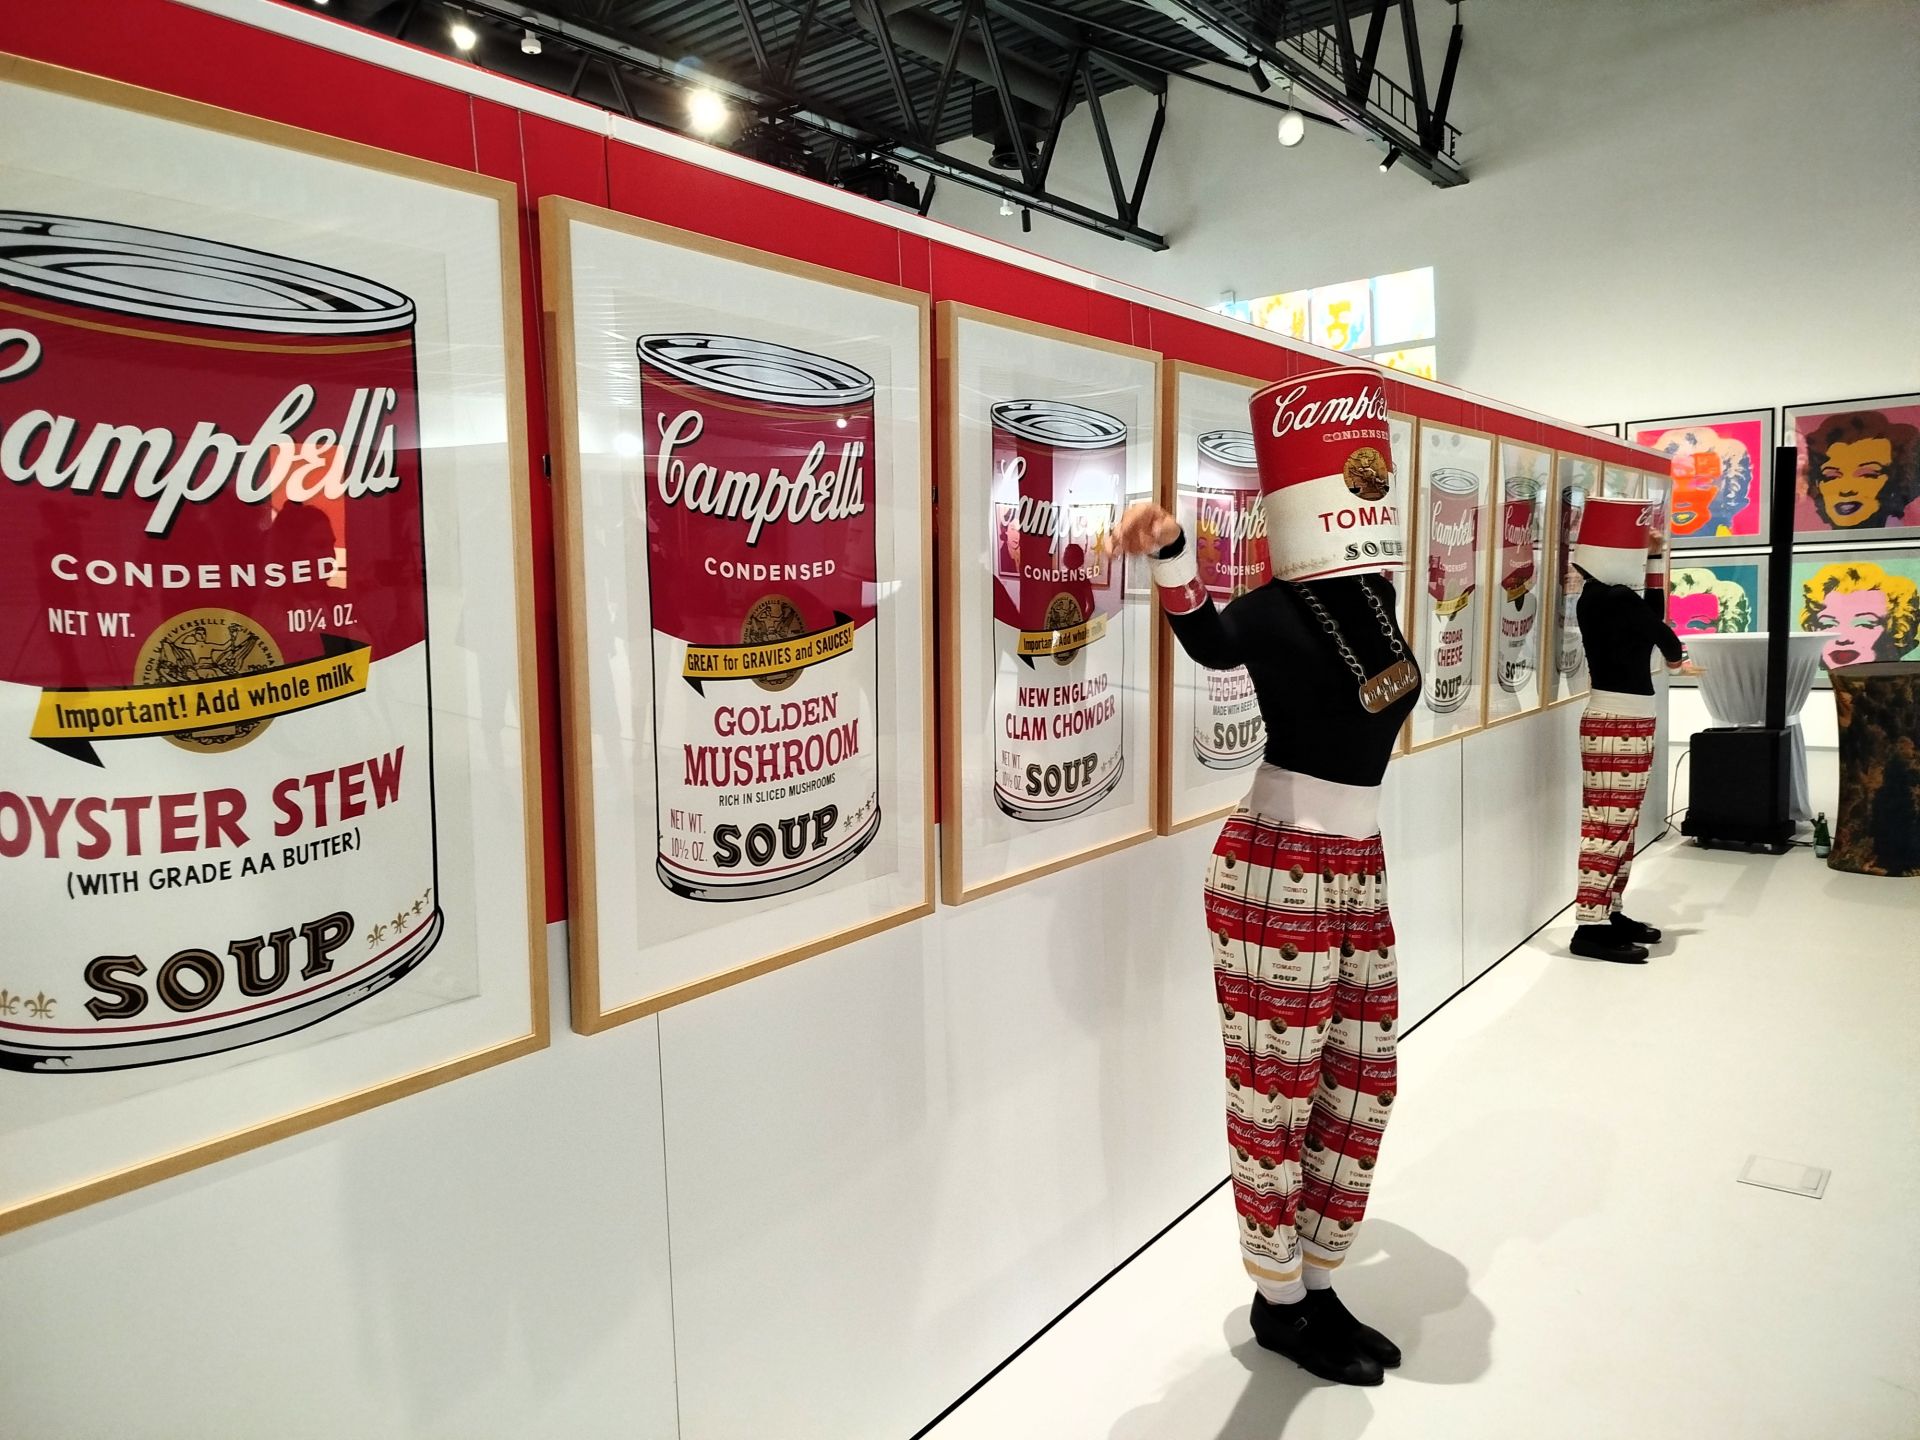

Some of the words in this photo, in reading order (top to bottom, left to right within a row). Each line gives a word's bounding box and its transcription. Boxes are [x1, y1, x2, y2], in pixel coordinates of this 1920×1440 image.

[0, 328, 401, 534] ampbell's
[1318, 506, 1399, 532] TOMAT
[51, 553, 339, 589] CONDENSED
[704, 557, 836, 581] CONDENSED
[1024, 564, 1101, 582] CONDENSED
[1215, 562, 1266, 576] CONDENSED
[48, 607, 87, 637] NET
[98, 612, 136, 638] WT.
[333, 604, 358, 628] OZ.
[687, 653, 719, 672] GREAT
[723, 655, 738, 671] for
[742, 647, 791, 669] GRAVIES
[795, 641, 813, 661] and
[816, 628, 852, 655] SAUCES!
[1437, 645, 1463, 667] CHEESE
[56, 693, 188, 732] Important!
[196, 687, 240, 716] Add
[248, 676, 310, 707] whole
[316, 661, 355, 692] milk
[1018, 686, 1049, 707] NEW
[1053, 673, 1108, 706] ENGLAND
[1435, 675, 1461, 699] SOUP
[714, 691, 838, 737] GOLDEN
[1005, 713, 1047, 741] CLAM
[1053, 694, 1116, 739] CHOWDER
[1213, 715, 1262, 750] SOUP
[684, 718, 859, 787] MUSHROOM
[719, 793, 739, 807] RICH
[743, 791, 753, 805] IN
[756, 787, 786, 803] SLICED
[788, 773, 836, 797] MUSHROOMS
[1025, 752, 1098, 797] SOUP
[0, 788, 250, 860] OYSTER
[272, 745, 404, 837] STEW
[670, 808, 684, 830] NET
[688, 812, 706, 834] WT.
[713, 804, 838, 868] SOUP
[67, 870, 139, 899] (WITH
[149, 860, 232, 889] GRADE
[240, 852, 276, 878] AA
[283, 827, 361, 868] BUTTER)
[84, 911, 355, 1021] SOUP
[1272, 962, 1301, 971] TOMATO
